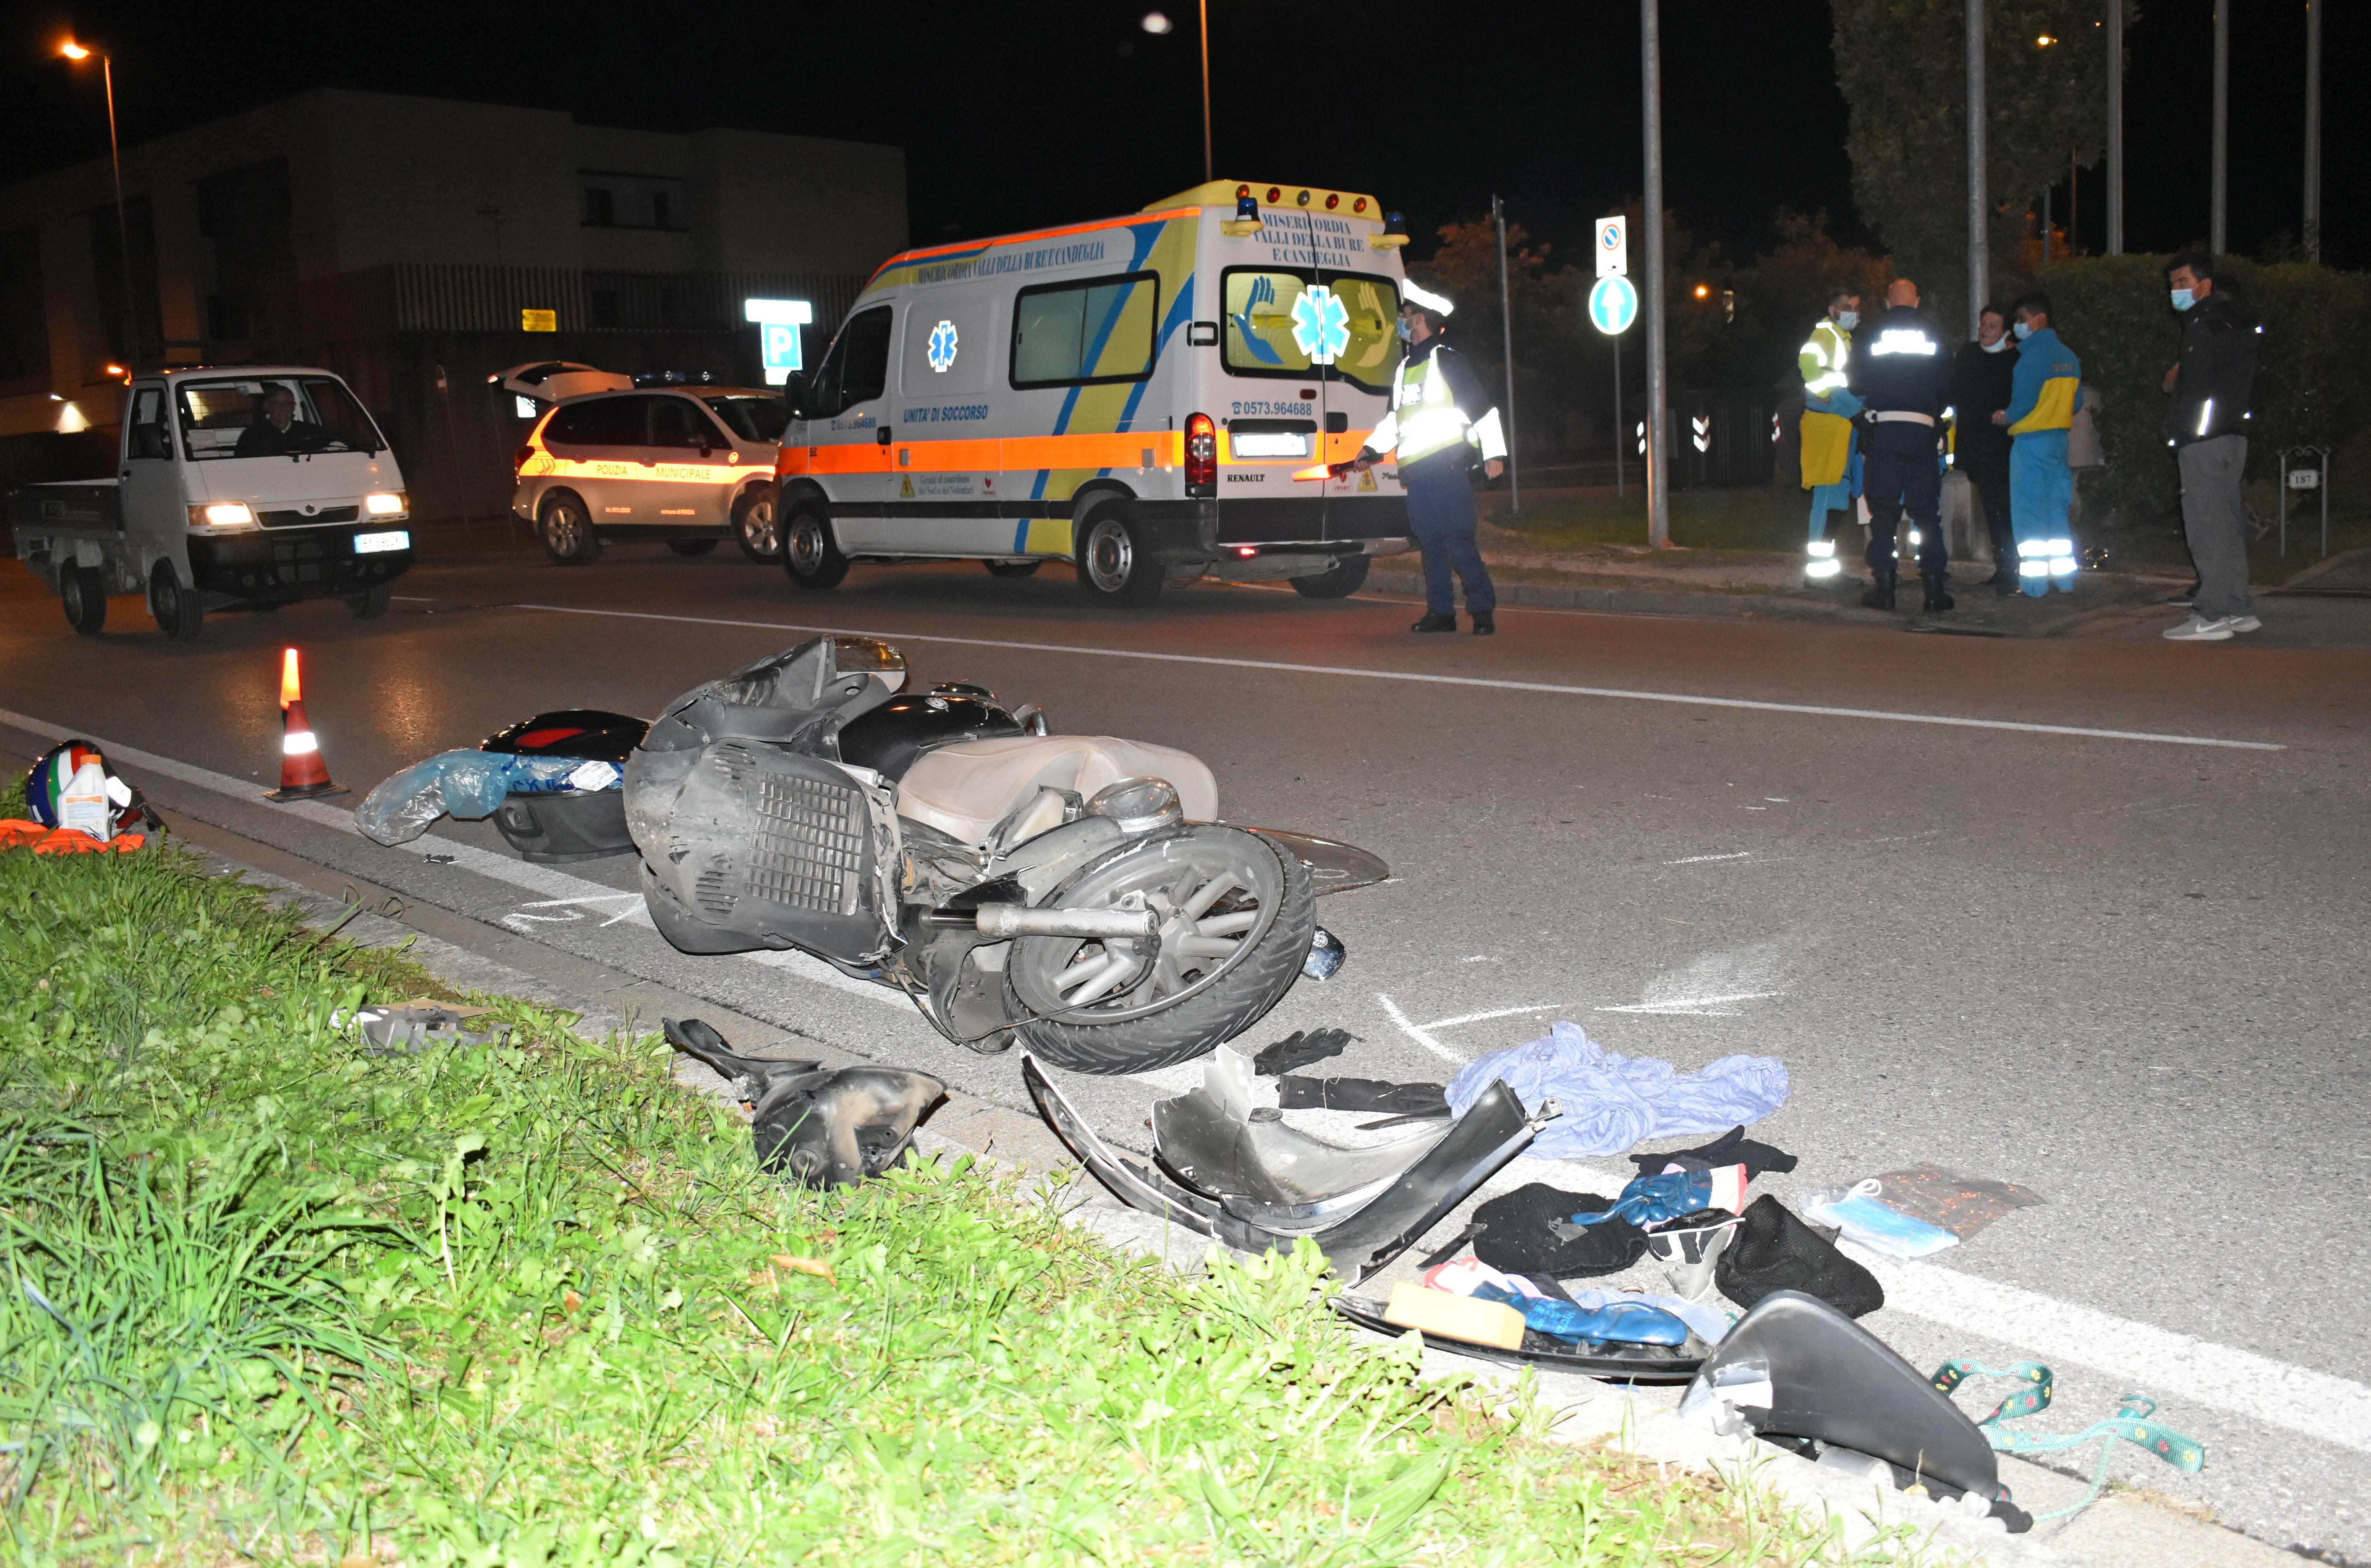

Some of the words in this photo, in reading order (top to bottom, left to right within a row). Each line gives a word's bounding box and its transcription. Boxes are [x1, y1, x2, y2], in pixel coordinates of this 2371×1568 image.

[1263, 213, 1351, 235] MISERICORDIA
[1254, 230, 1289, 245] VALLI
[1292, 232, 1332, 248] DELLA
[1334, 236, 1364, 252] BURE
[996, 253, 1023, 274] DELLA
[1024, 250, 1048, 270] BURE
[1048, 248, 1055, 267] E
[1055, 240, 1104, 266] CANDEGLIA
[1273, 248, 1281, 261] E
[1283, 248, 1351, 267] CANDEGLIA
[769, 327, 793, 364] P
[904, 408, 930, 423] UNITA'
[931, 407, 940, 422] DI
[942, 405, 988, 421] SOCCORSO
[1243, 401, 1312, 416] 0573.964688
[597, 465, 628, 476] POLIZIA
[656, 468, 711, 480] MUNICIPALE
[2295, 475, 2311, 484] 187
